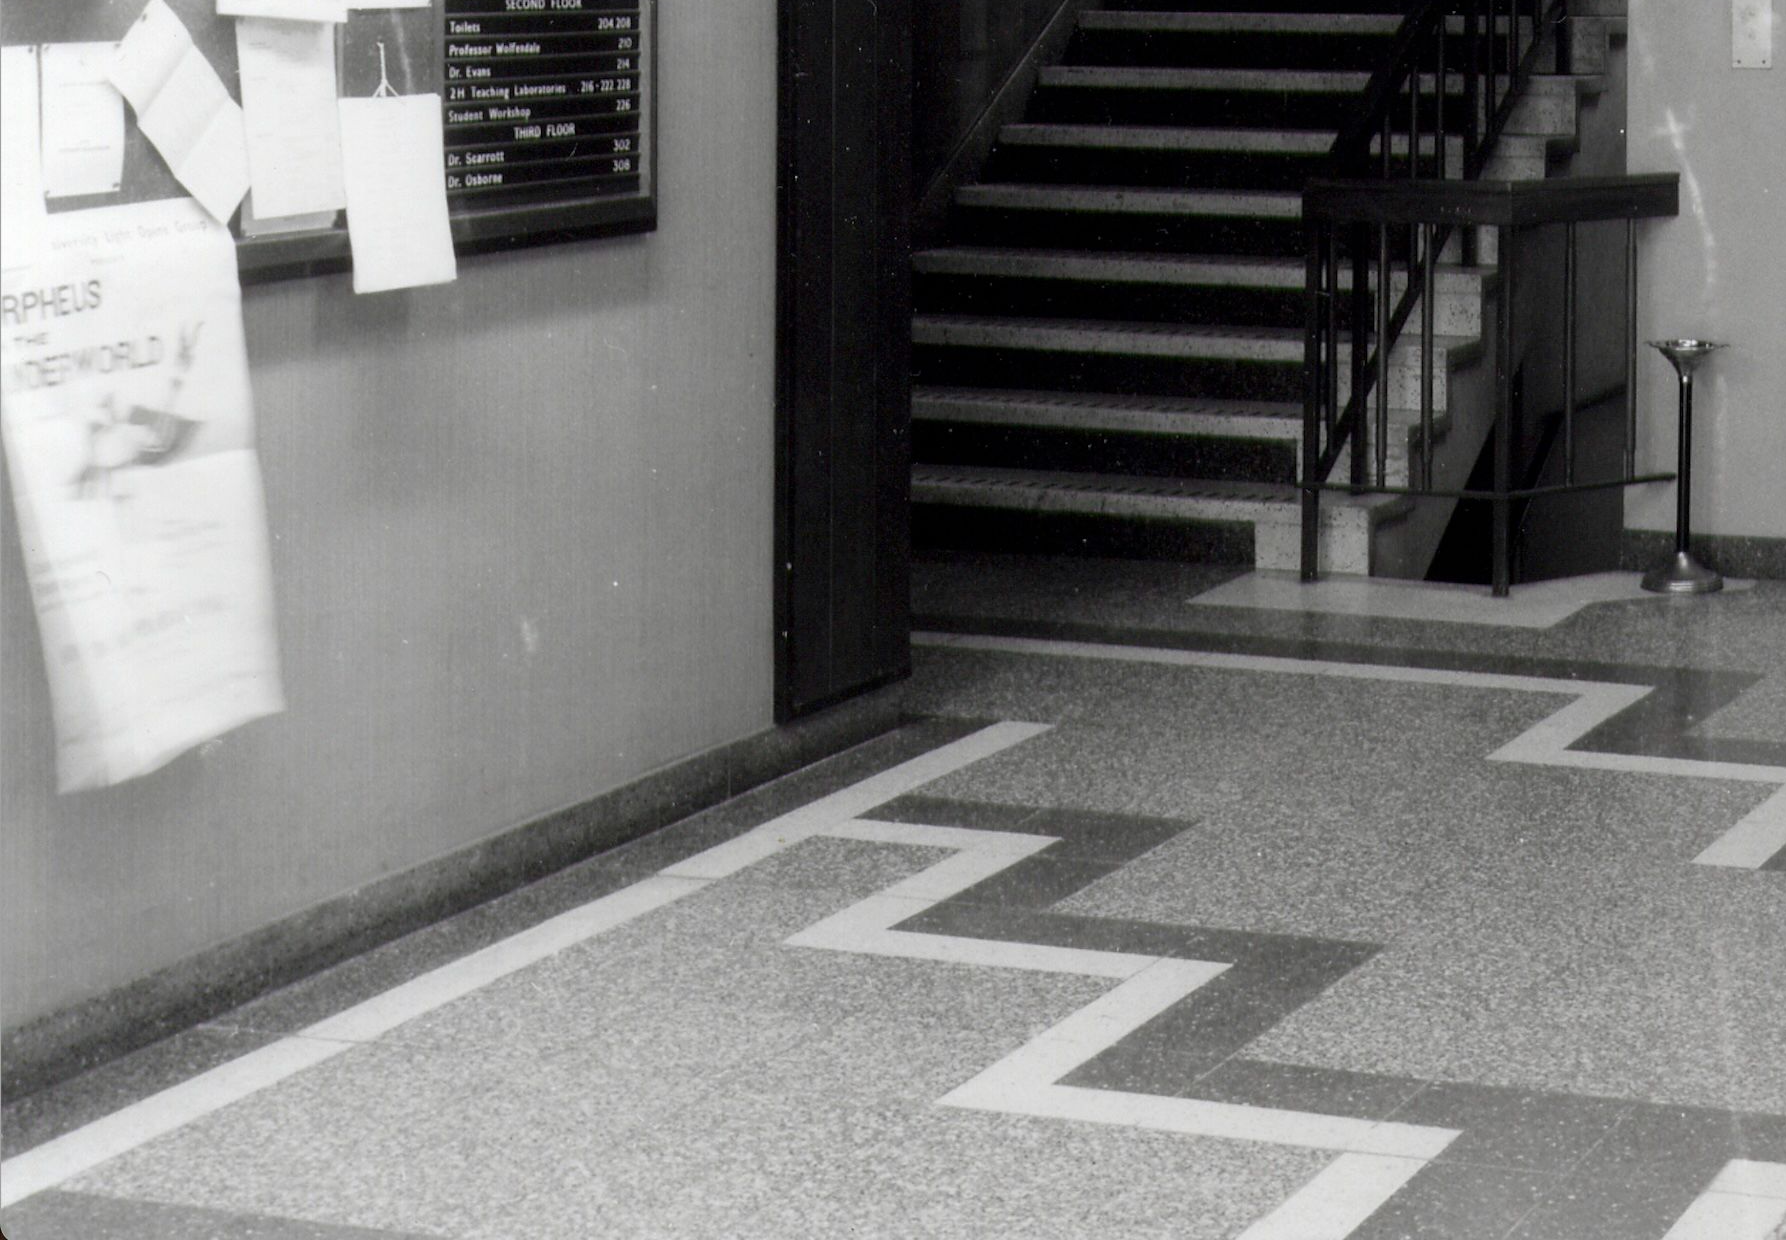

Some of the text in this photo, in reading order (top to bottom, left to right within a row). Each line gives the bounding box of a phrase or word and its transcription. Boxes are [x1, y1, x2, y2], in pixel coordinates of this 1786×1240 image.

[450, 21, 480, 33] Toilets
[449, 38, 632, 56] Professor Wolfendale 210
[449, 59, 630, 78] Dr. Evans 214
[472, 87, 509, 100] Teaching
[514, 84, 566, 97] Laboratories
[448, 100, 631, 122] Student Workshop 226
[514, 123, 575, 139] THIRD FLOOR
[448, 139, 630, 166] Dr. Scarrott 302
[448, 160, 631, 188] Dr. Osborne 308
